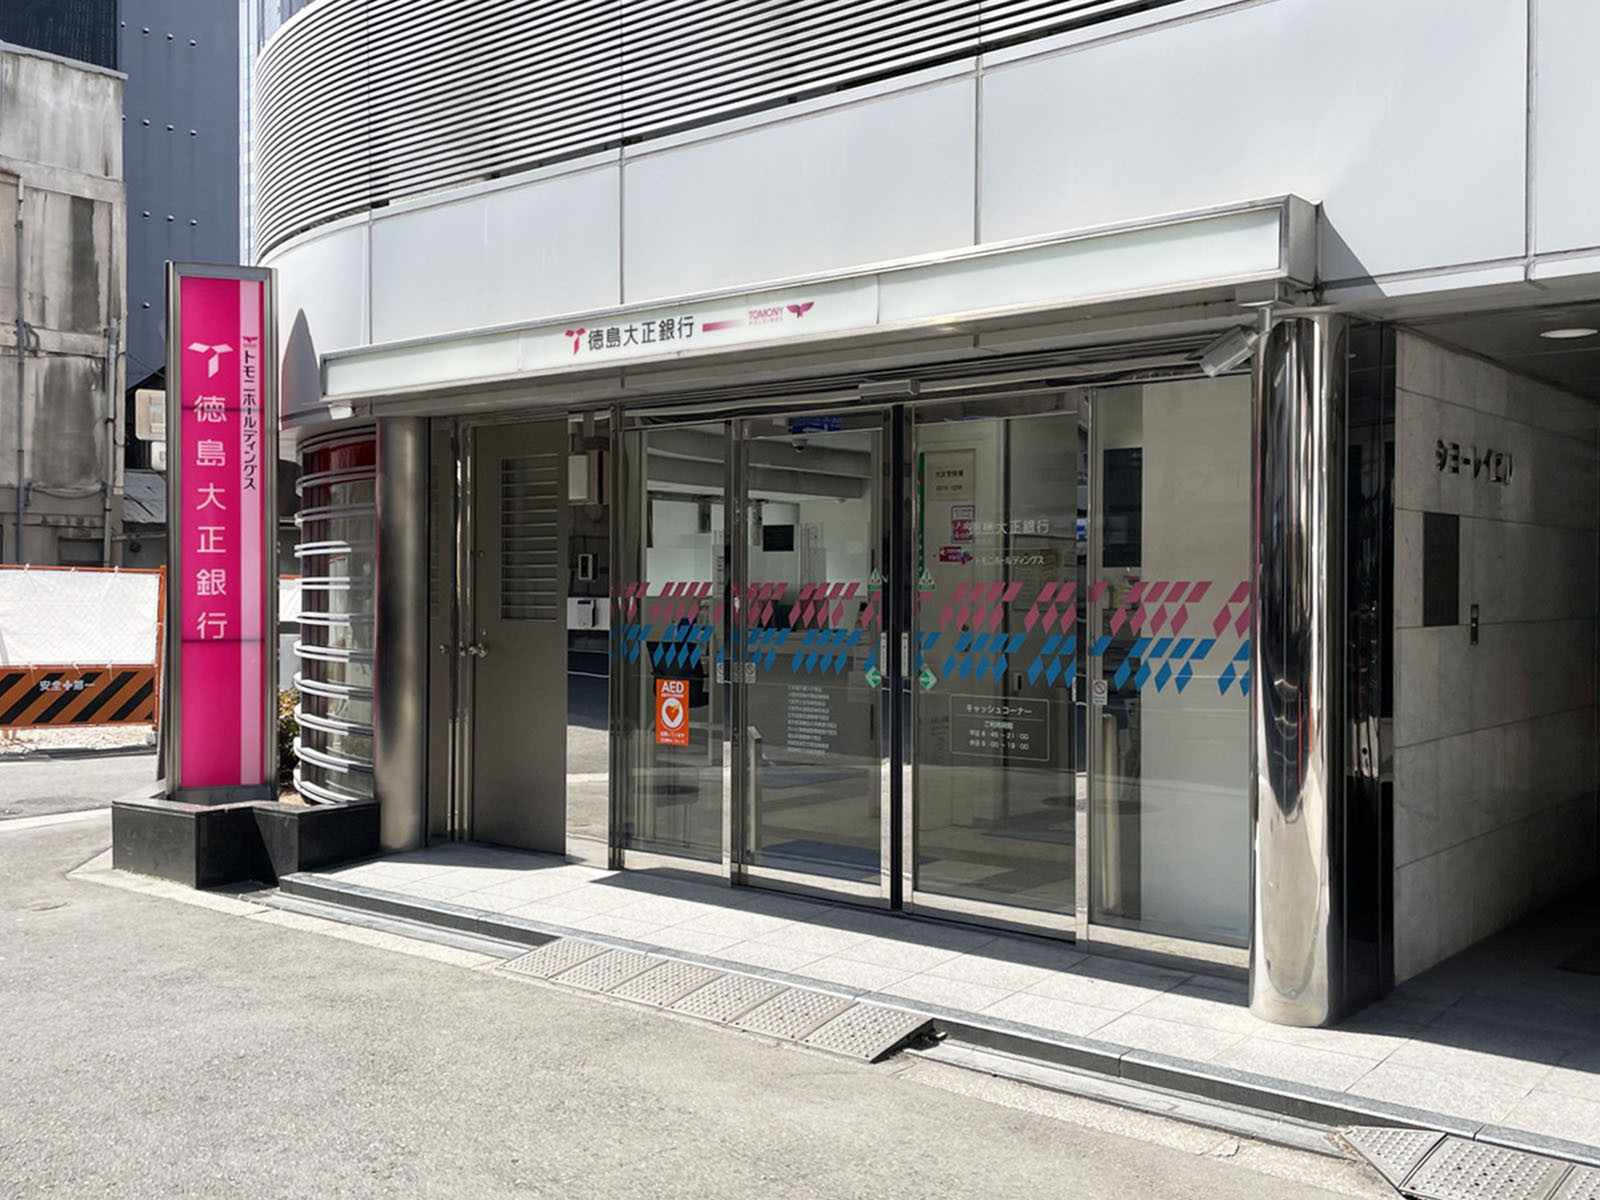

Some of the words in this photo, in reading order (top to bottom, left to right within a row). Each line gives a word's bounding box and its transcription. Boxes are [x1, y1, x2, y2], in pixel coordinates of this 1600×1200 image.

[748, 306, 784, 319] TOMONY
[587, 315, 695, 351] 徳島大正銀行
[242, 349, 258, 490] トモニホールディングス
[193, 394, 228, 640] 徳島大正銀行
[661, 680, 685, 694] AED
[966, 703, 1033, 717] キャッシュコーナー
